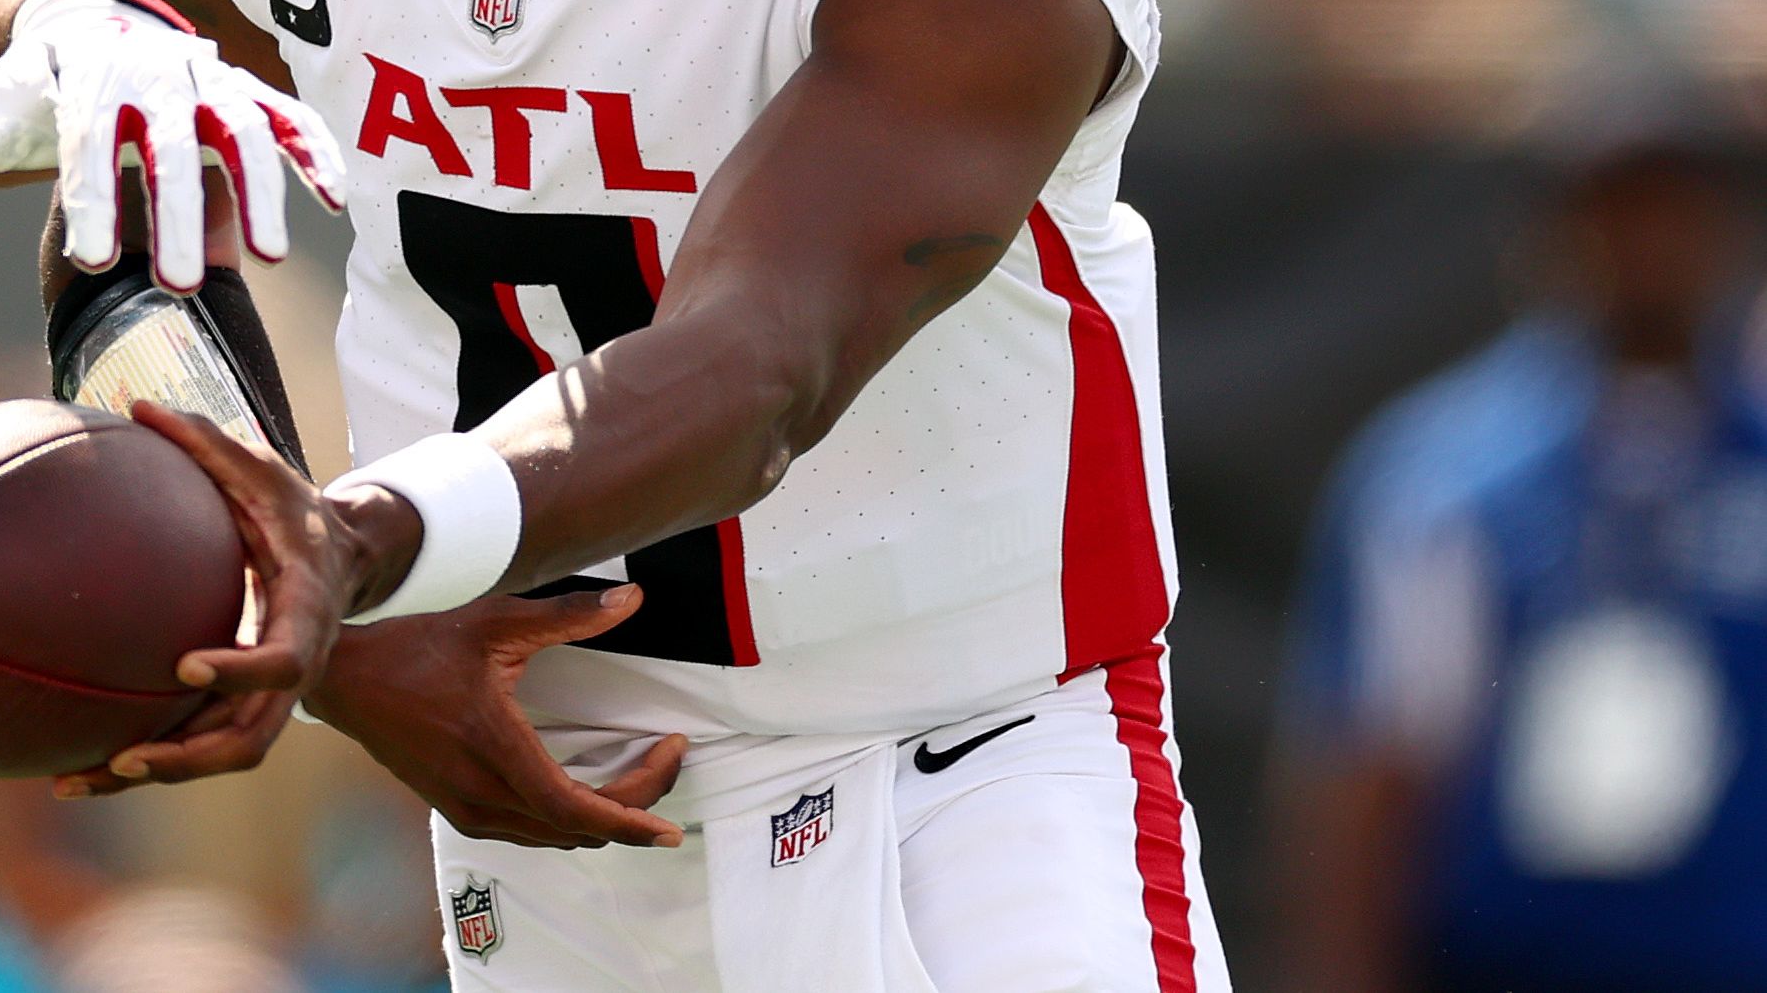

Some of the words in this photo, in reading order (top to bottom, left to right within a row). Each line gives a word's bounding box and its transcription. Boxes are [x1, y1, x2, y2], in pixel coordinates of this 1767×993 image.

[356, 52, 697, 194] ATL
[777, 817, 827, 863] NFL
[459, 915, 495, 947] NFL
